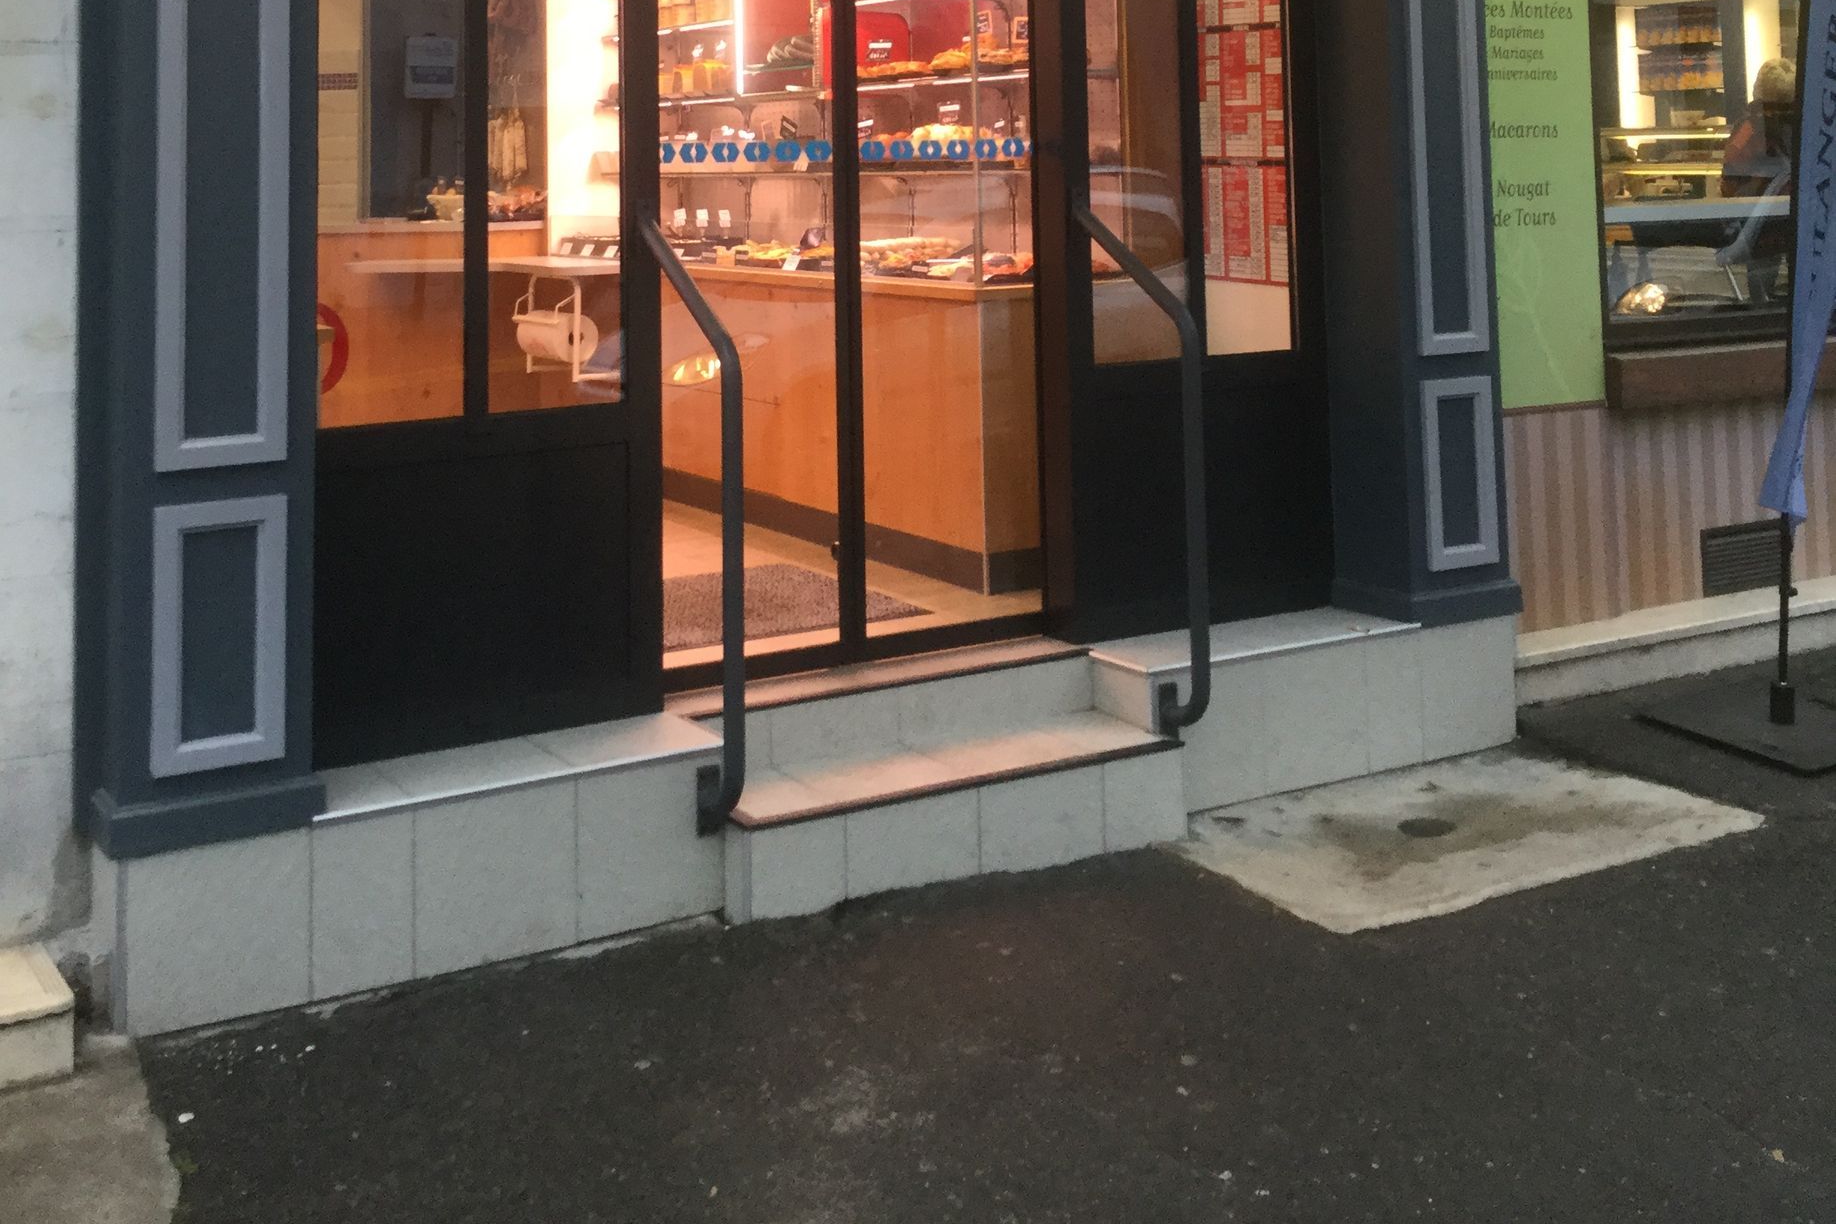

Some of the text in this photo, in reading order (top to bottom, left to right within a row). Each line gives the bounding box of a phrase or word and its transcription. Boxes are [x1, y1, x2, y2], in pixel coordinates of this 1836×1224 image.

[1510, 1, 1573, 20] Montées
[1492, 46, 1544, 63] Mariages
[1497, 179, 1551, 201] Nougat
[1493, 208, 1556, 227] de Tours
